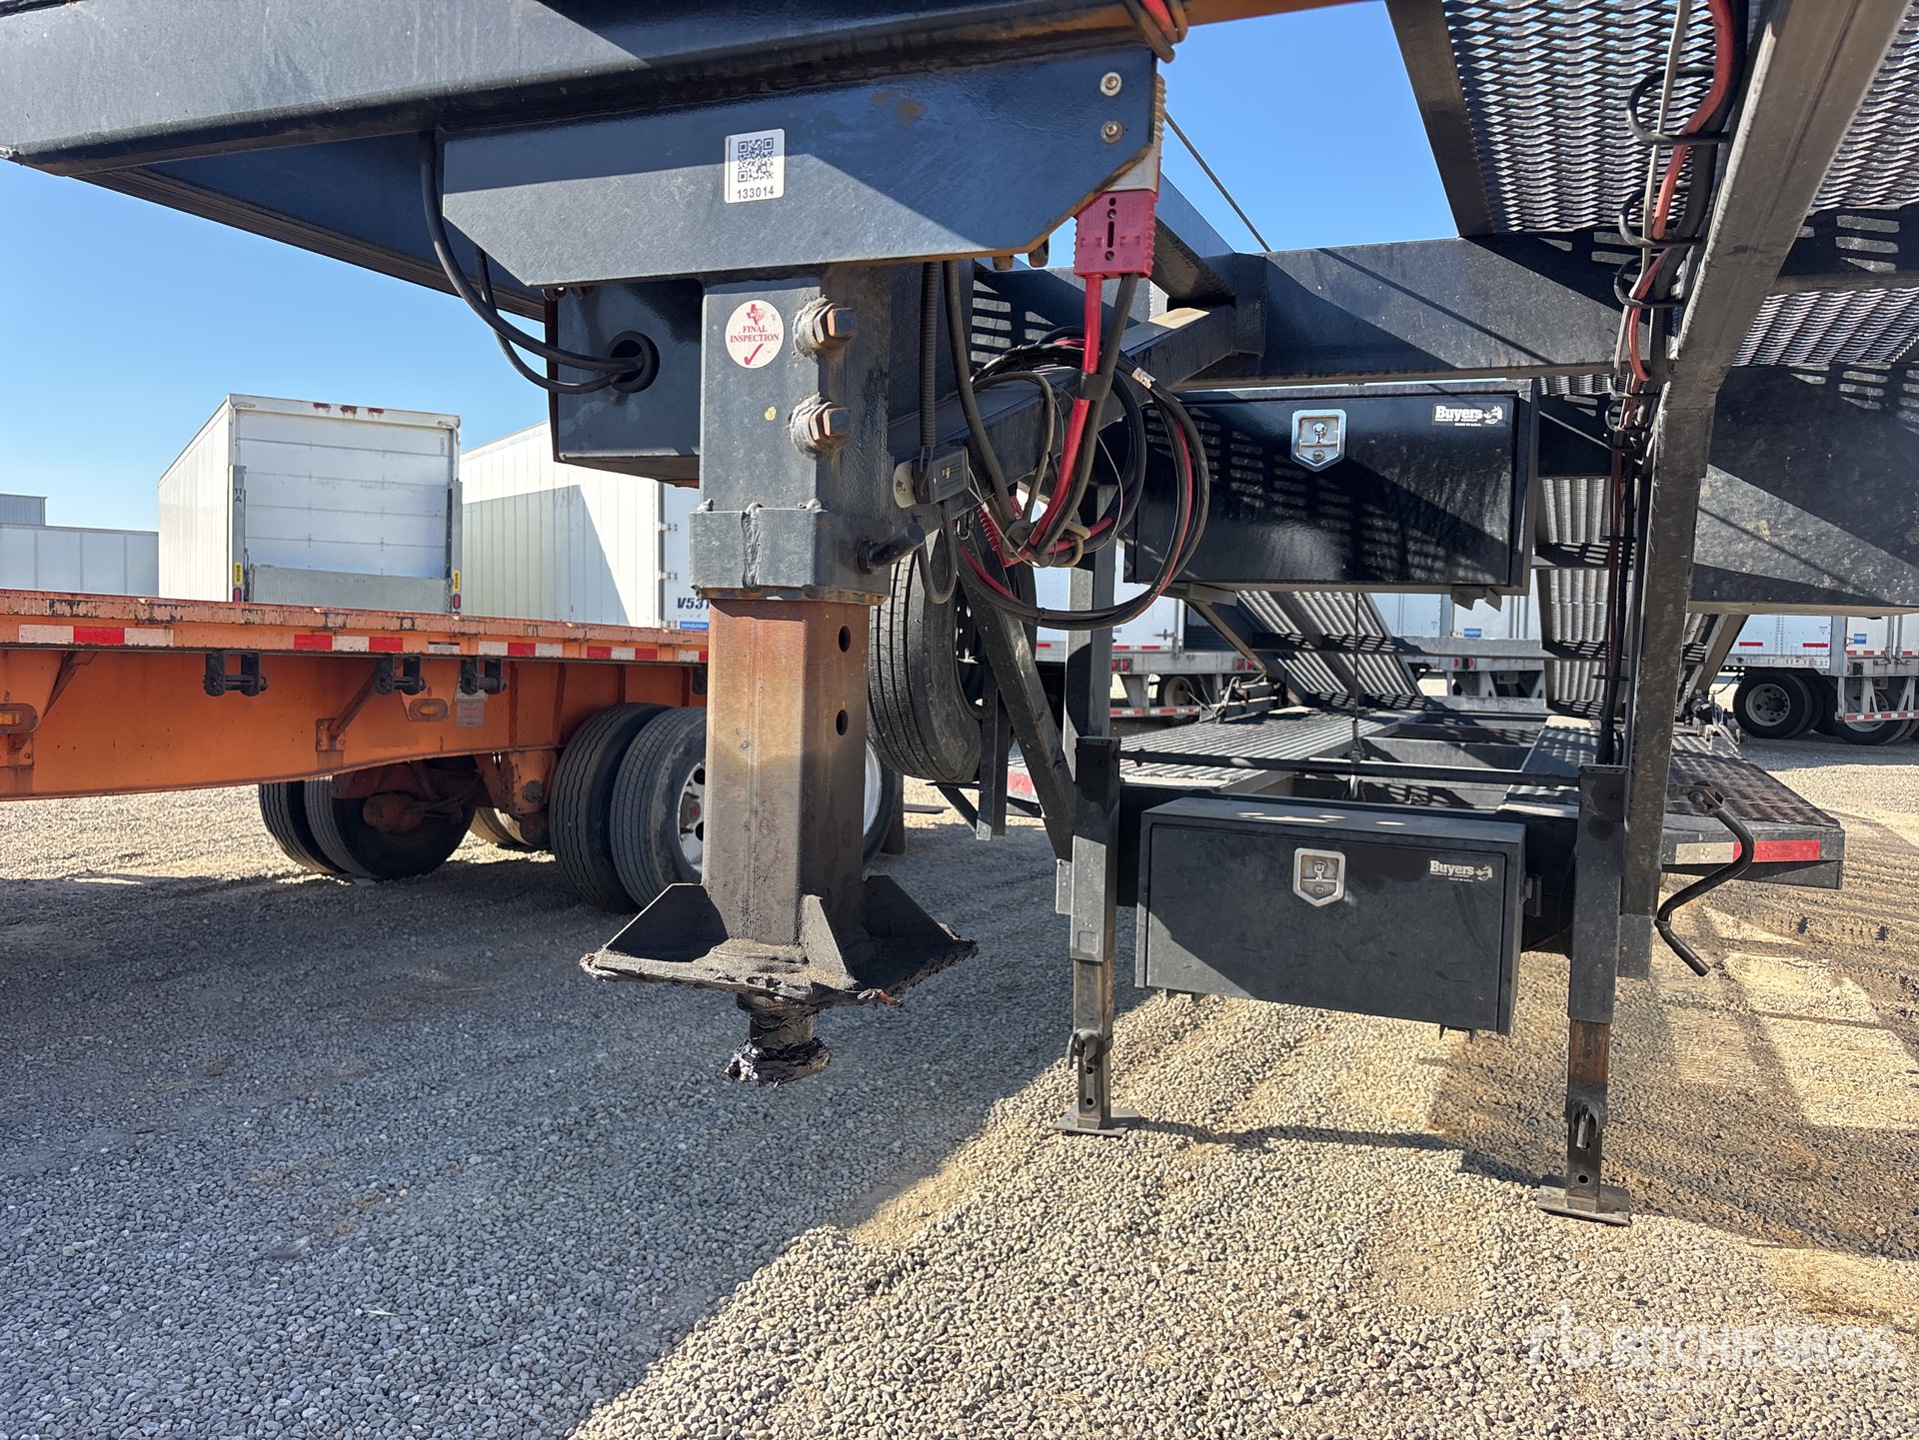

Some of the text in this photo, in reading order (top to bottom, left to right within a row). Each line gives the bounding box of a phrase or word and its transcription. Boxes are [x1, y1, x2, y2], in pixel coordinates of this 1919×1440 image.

[737, 186, 775, 199] 133014
[743, 325, 768, 333] FINAL
[730, 333, 780, 343] INSPECTION
[1435, 405, 1483, 422] Buyers
[1429, 860, 1475, 876] Buyers
